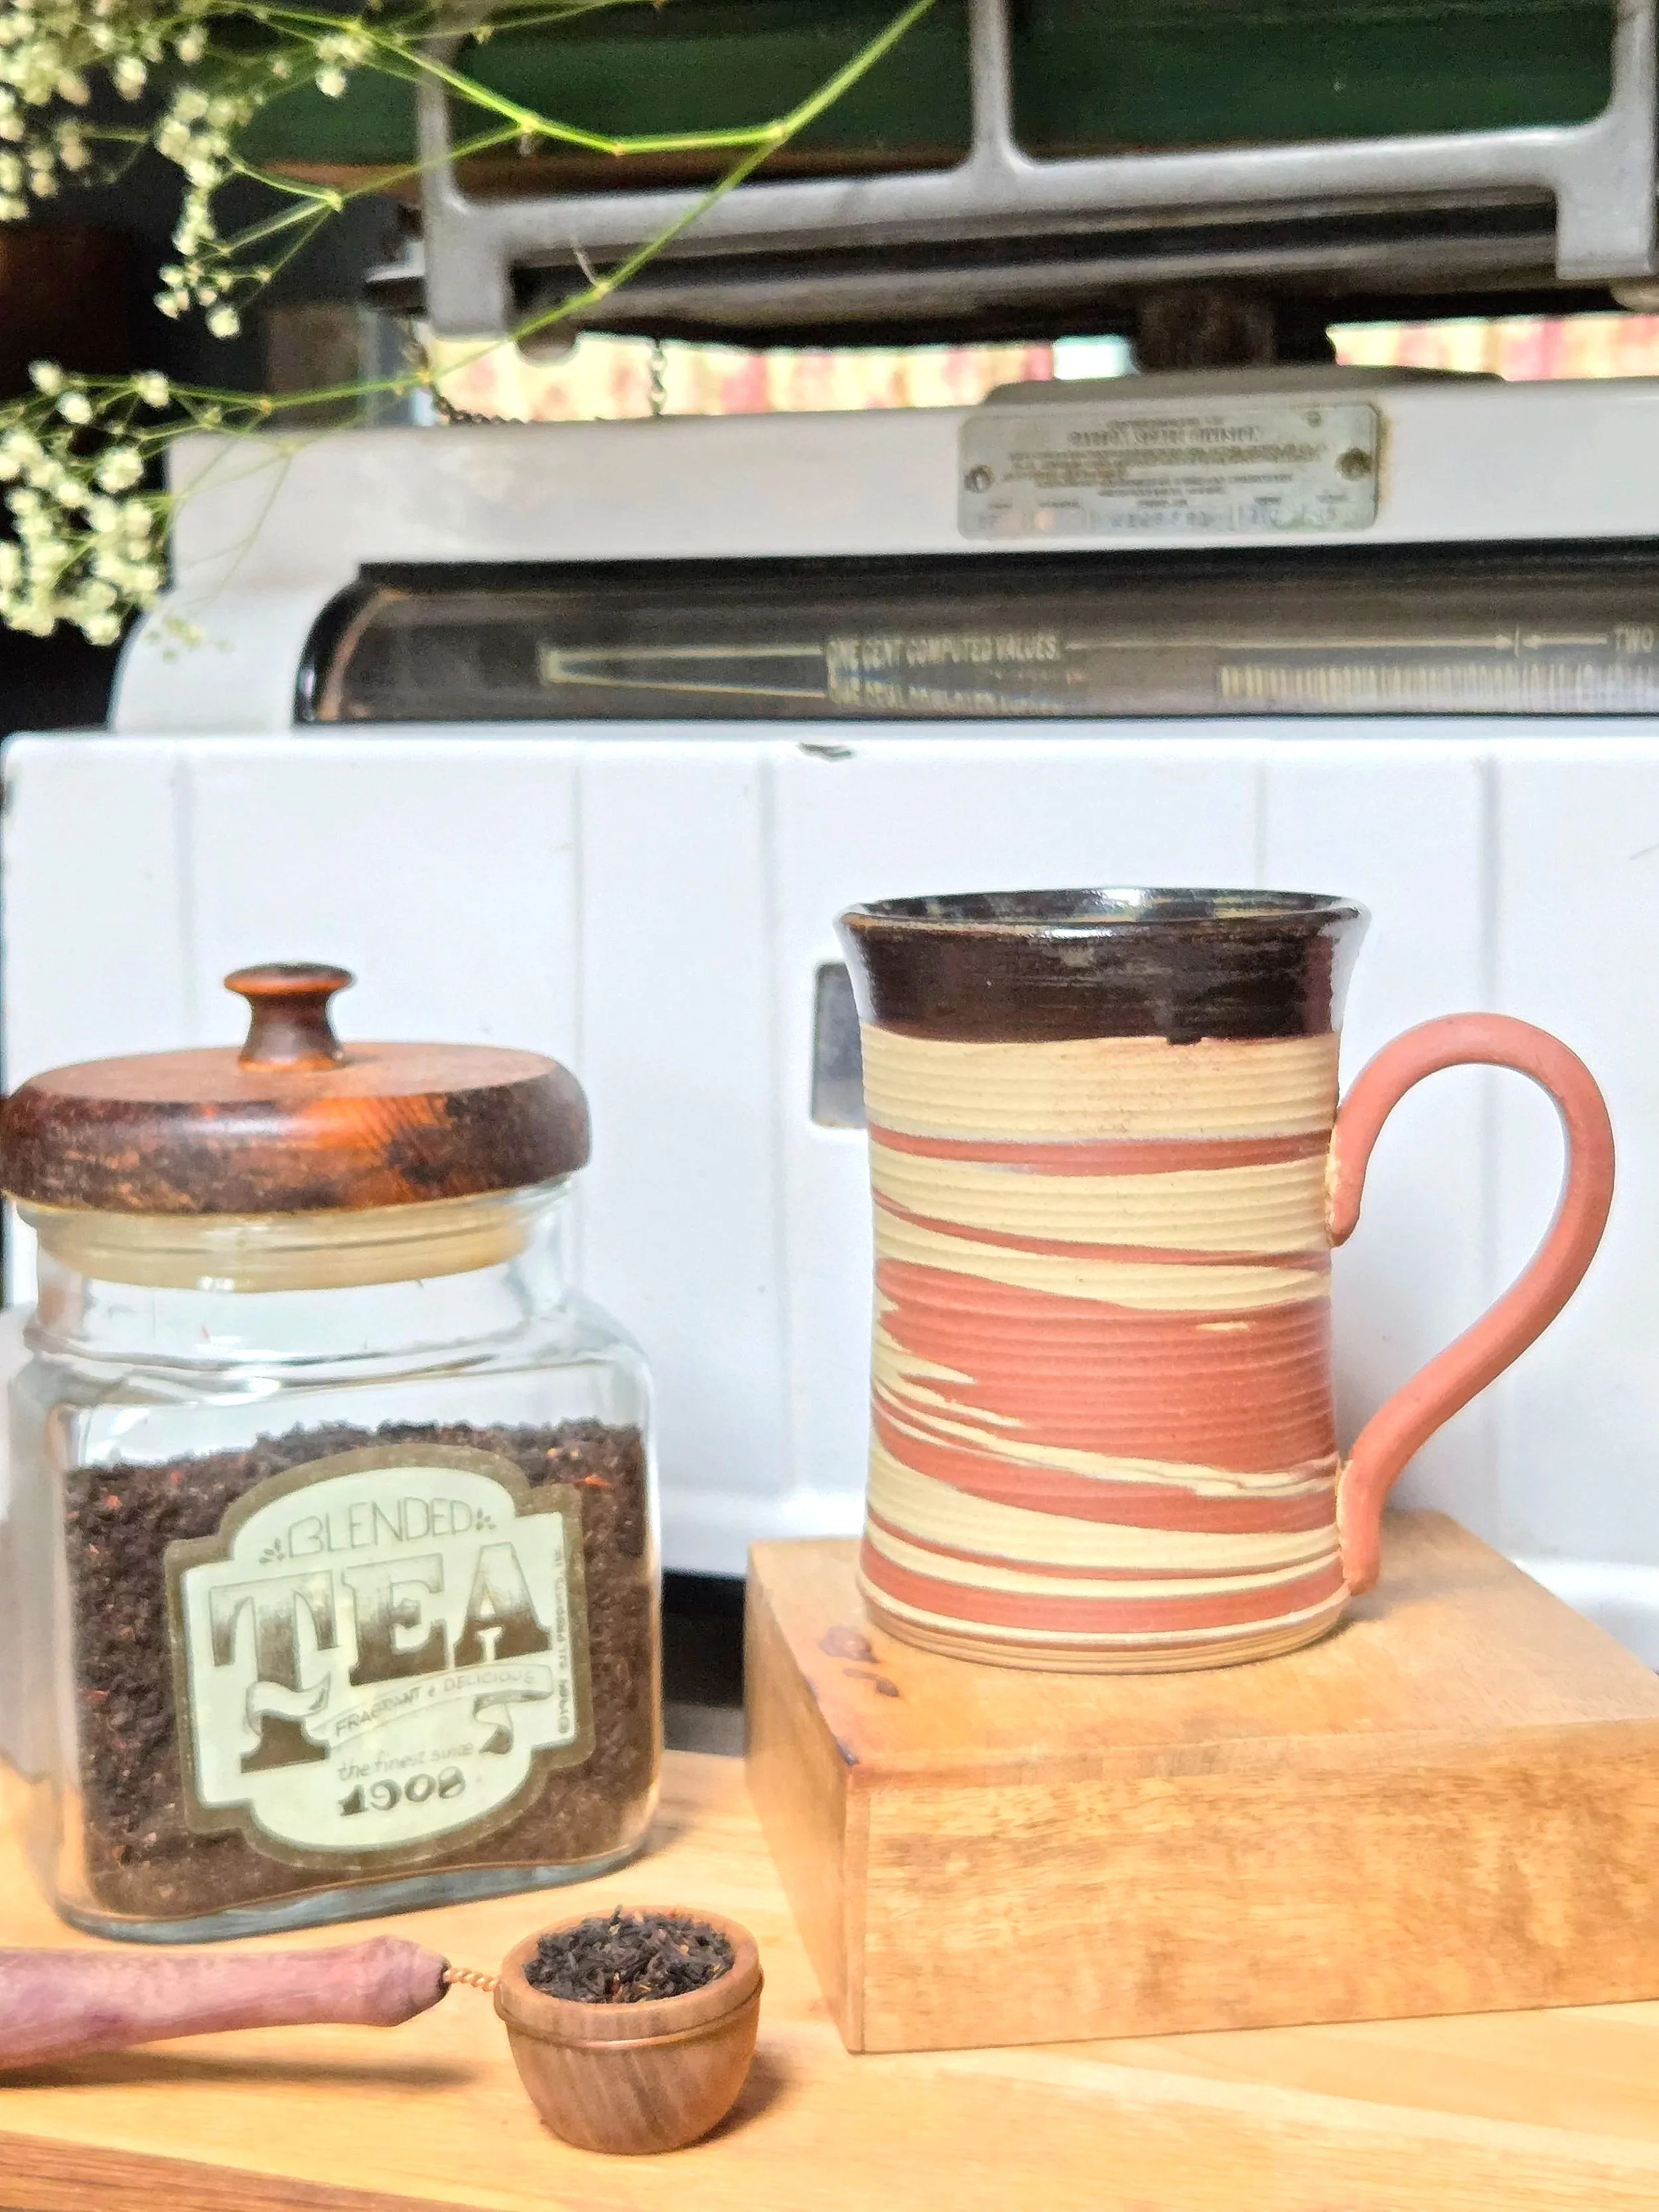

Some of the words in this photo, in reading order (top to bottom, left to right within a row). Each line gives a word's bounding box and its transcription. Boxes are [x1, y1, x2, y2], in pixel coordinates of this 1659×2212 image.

[287, 1497, 473, 1558] BLENDED
[209, 1542, 552, 1773] TEA
[334, 1685, 423, 1737] FRAGRANT
[443, 1670, 536, 1692] DELICIOUS
[338, 1759, 371, 1781] the
[376, 1750, 426, 1773] finest
[432, 1742, 474, 1761] since
[338, 1765, 467, 1816] 1908
